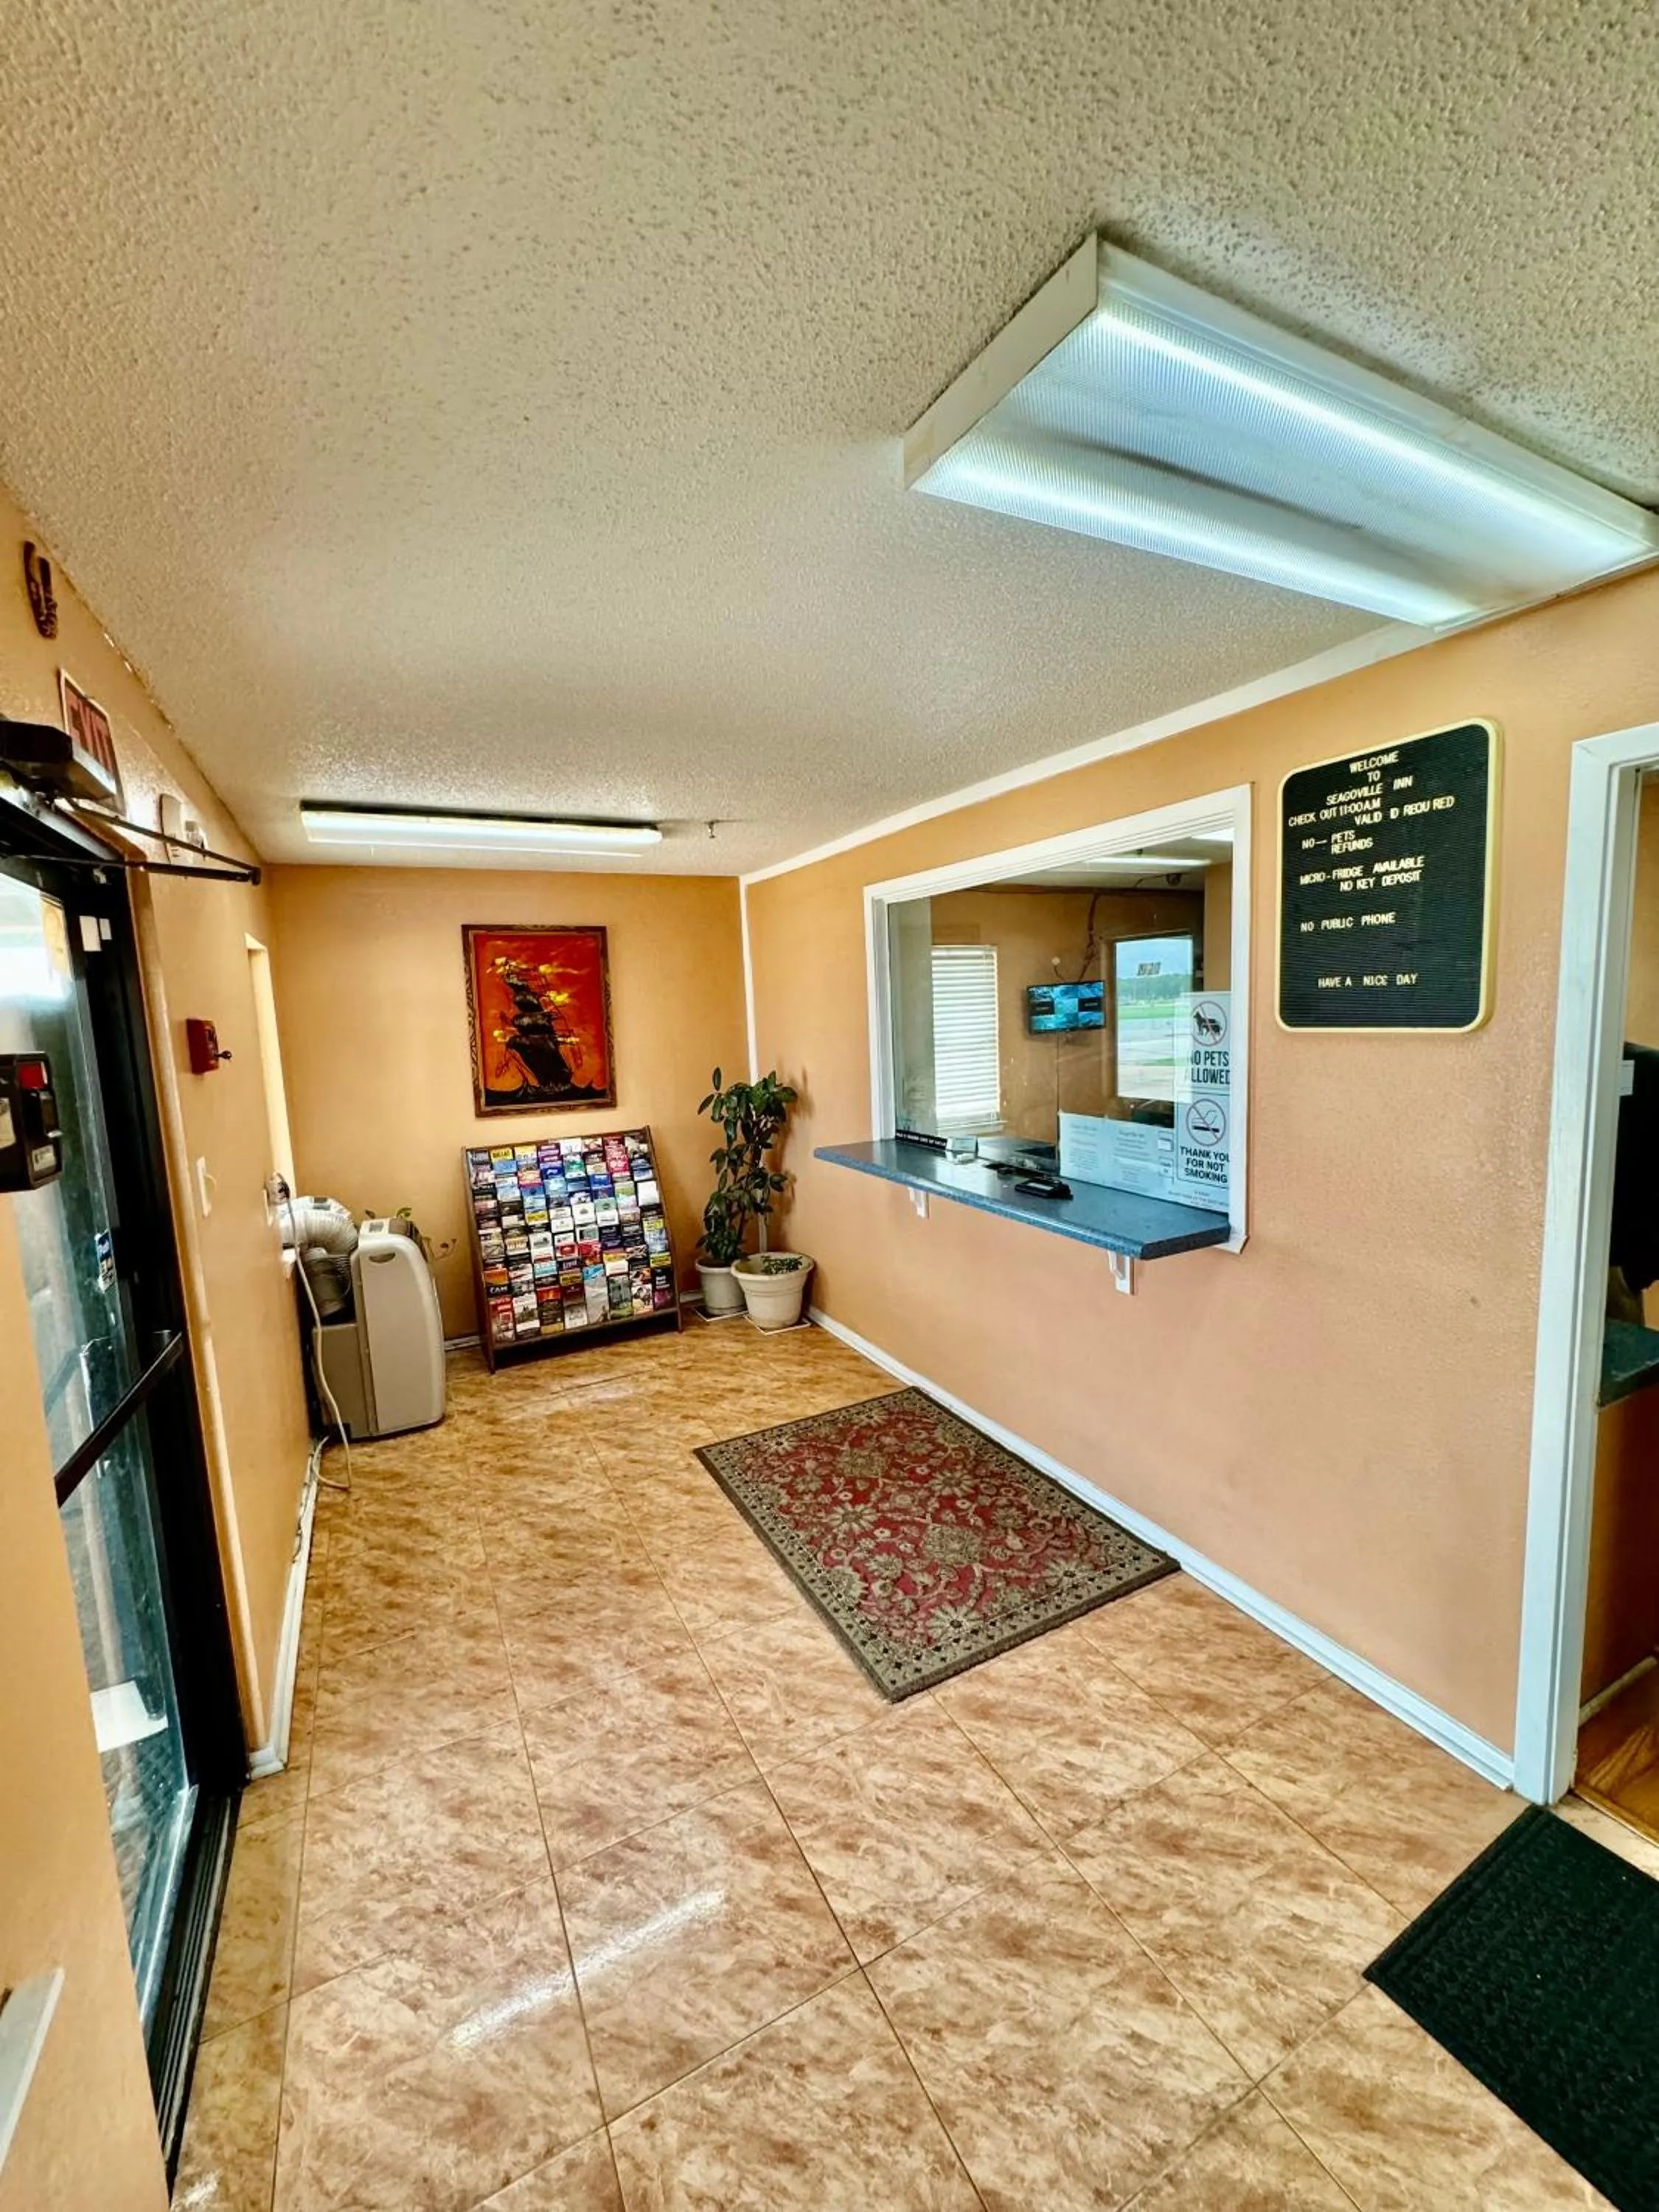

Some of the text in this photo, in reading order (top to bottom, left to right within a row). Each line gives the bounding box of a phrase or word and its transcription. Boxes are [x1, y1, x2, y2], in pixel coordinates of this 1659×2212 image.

[1349, 751, 1399, 773] WELCOME
[1367, 771, 1381, 782] TO
[1326, 776, 1413, 806] SEAGOVILLE INN
[1288, 813, 1317, 827] CHECK
[1319, 807, 1338, 820] OUT
[1354, 811, 1382, 826] VALID
[1390, 807, 1399, 819] ID
[1331, 830, 1356, 844] PETS
[1331, 837, 1374, 855] REFUNDS
[1372, 855, 1425, 874] AVAILABLE
[1340, 869, 1422, 892] NO KEY DEPOSIT
[1300, 911, 1397, 933] NO PUBLIC PHONE
[1318, 973, 1419, 989] HAVE A NICE DAY
[1204, 1051, 1229, 1067] PETS
[1180, 1145, 1211, 1160] THANK
[1186, 1158, 1225, 1172] FOR NOT
[1184, 1167, 1228, 1183] SMOKING
